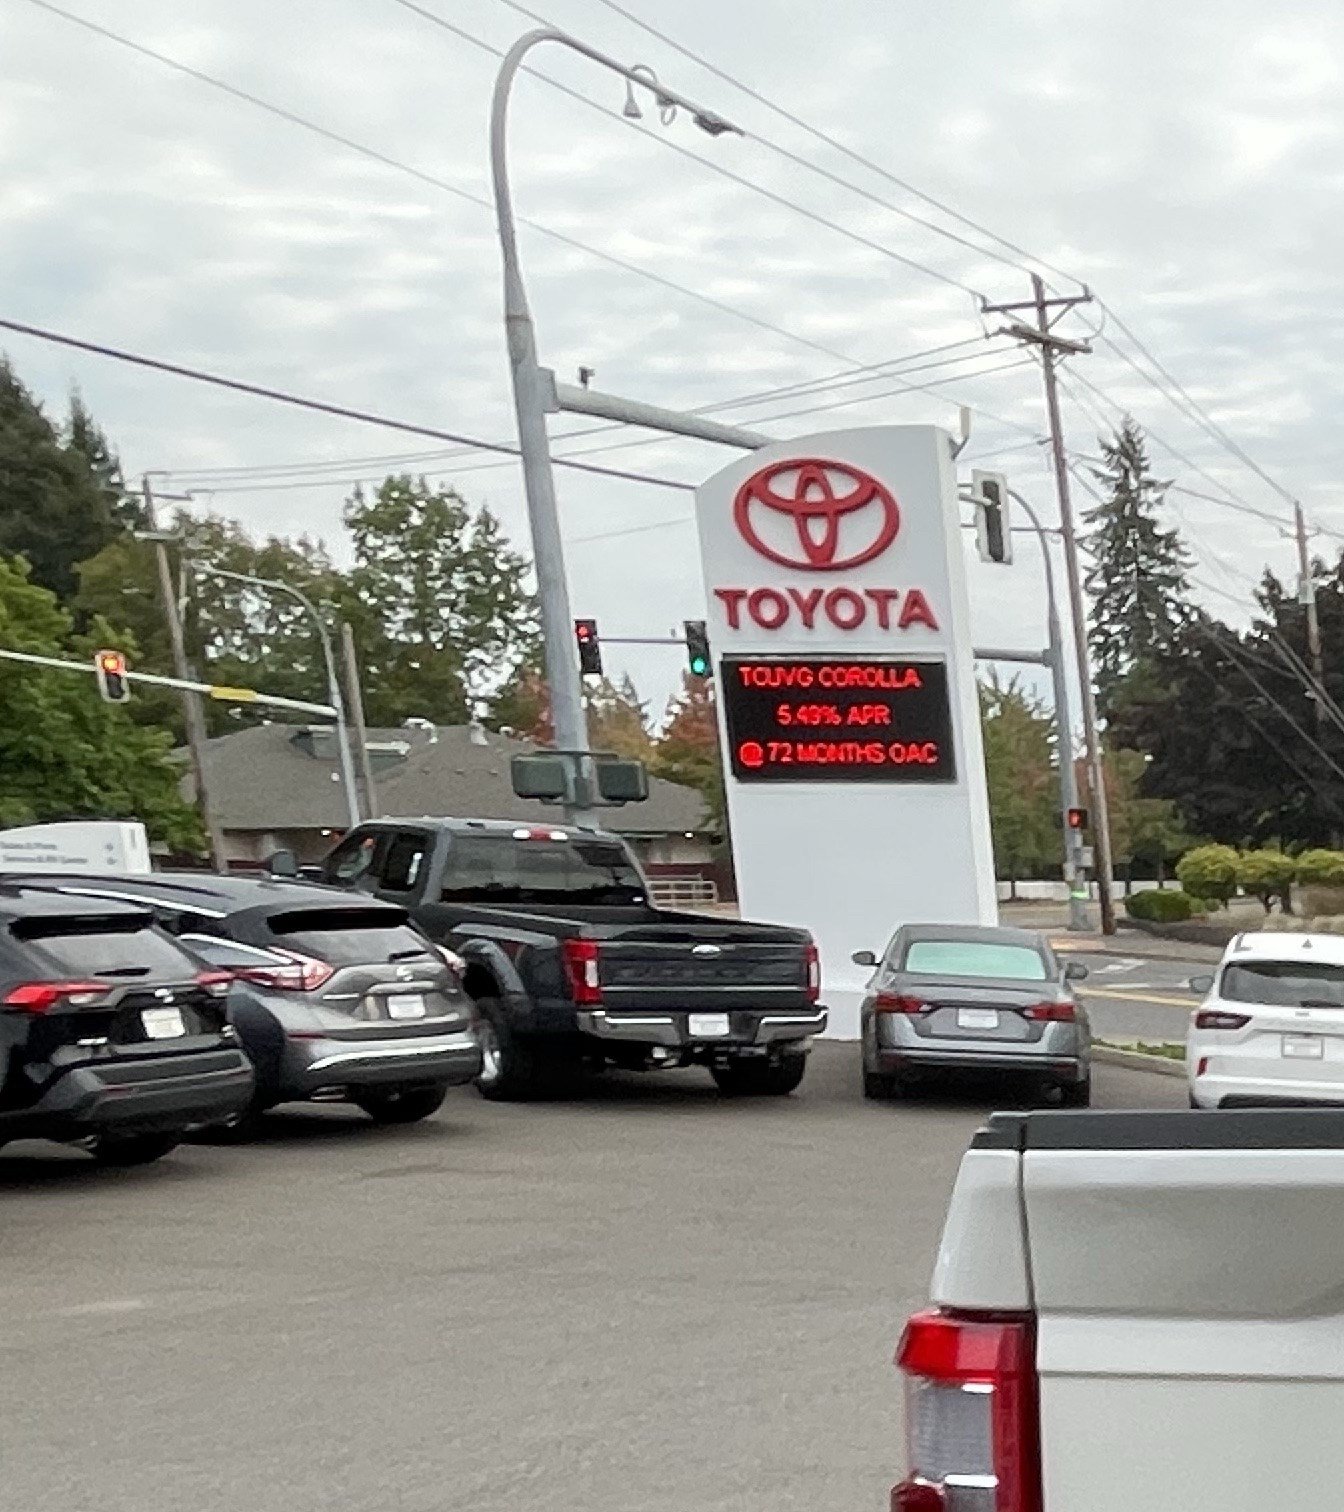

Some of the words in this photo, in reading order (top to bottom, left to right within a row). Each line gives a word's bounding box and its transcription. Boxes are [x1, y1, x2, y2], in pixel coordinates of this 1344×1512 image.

[713, 587, 939, 632] TOYOTA
[818, 666, 922, 689] COROLLA
[847, 704, 892, 726] APR
[767, 742, 793, 763] 72
[796, 742, 886, 764] MONTHS
[888, 742, 938, 765] OAC
